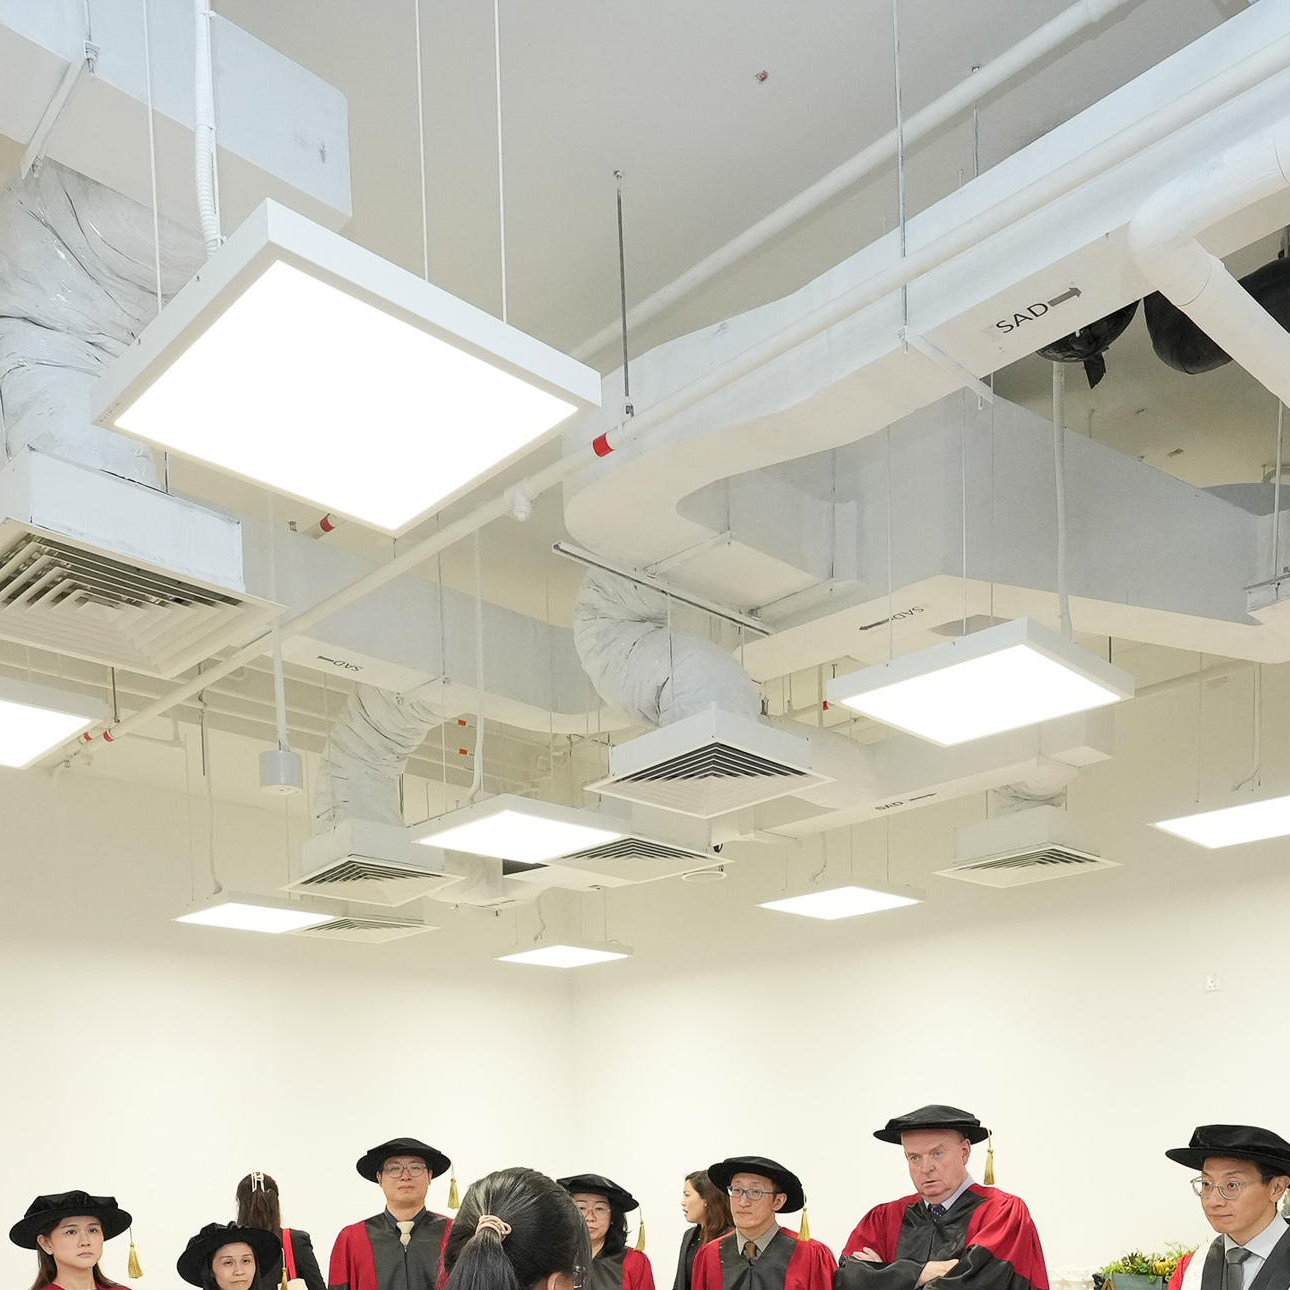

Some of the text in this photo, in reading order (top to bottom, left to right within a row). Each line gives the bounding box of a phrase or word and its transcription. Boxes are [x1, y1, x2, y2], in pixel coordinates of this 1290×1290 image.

[995, 302, 1049, 333] SAD
[892, 606, 924, 619] SAD
[333, 660, 363, 671] SAD
[875, 801, 904, 810] SAD
